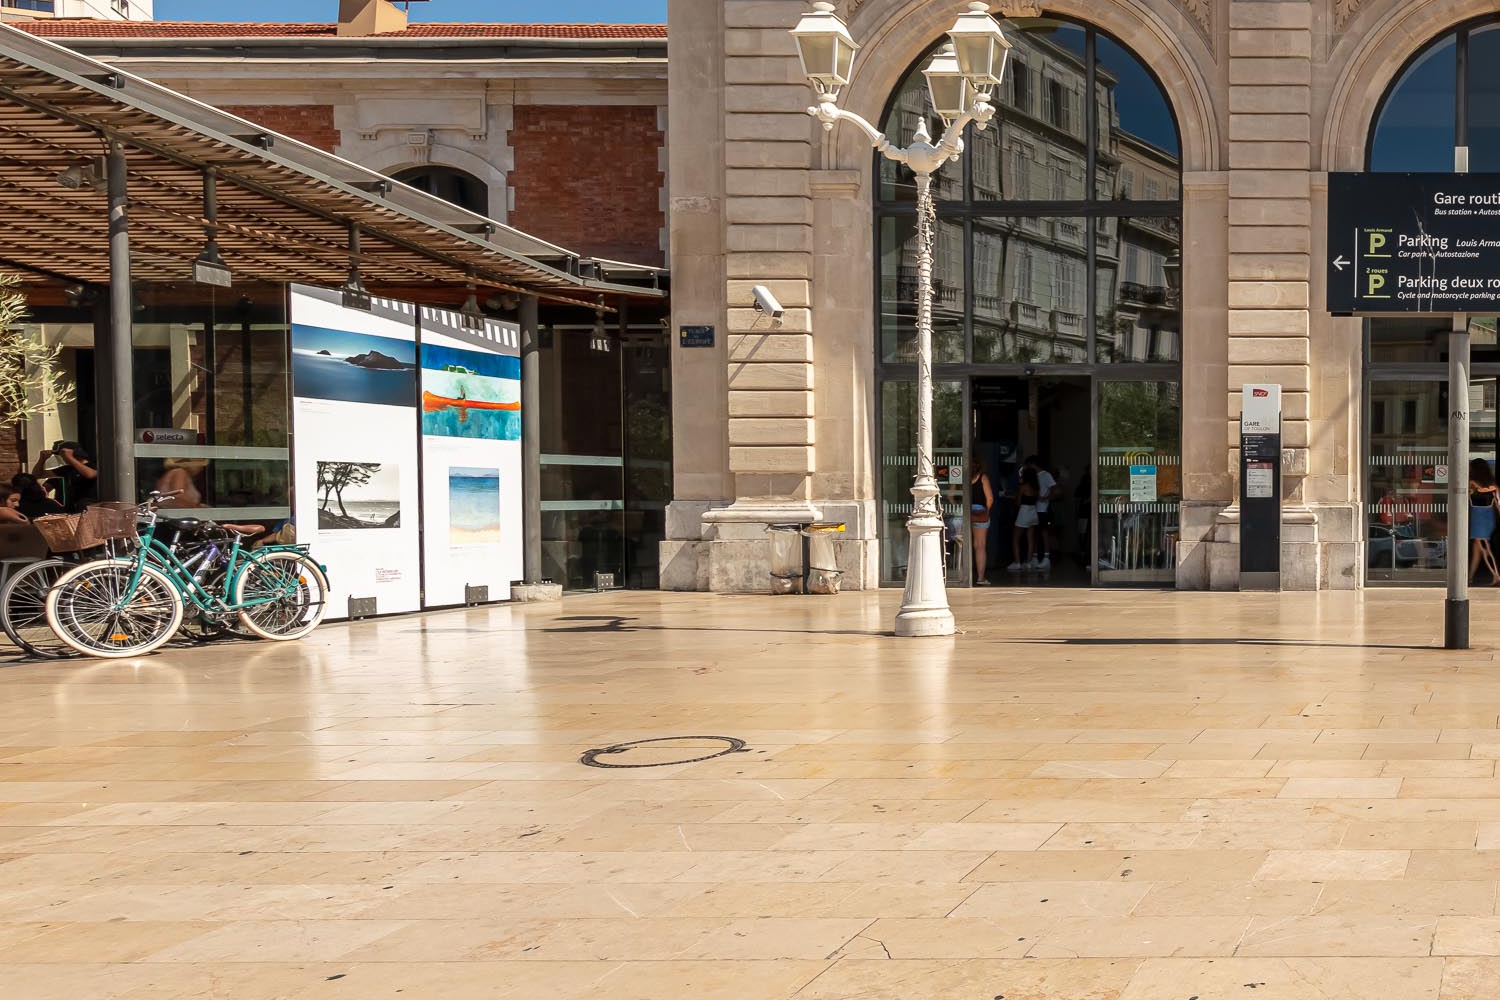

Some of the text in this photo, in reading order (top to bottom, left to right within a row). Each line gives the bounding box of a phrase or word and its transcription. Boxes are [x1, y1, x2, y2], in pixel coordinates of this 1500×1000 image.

[1434, 192, 1466, 205] Gare
[1434, 208, 1447, 216] Bus
[1448, 208, 1472, 216] station
[1398, 234, 1449, 250] Parking
[1456, 239, 1478, 248] Louis
[1398, 250, 1480, 259] Car park Autostazione
[1398, 275, 1448, 291] Parking
[1451, 275, 1484, 288] deux
[1397, 291, 1416, 300] Cycle
[1431, 292, 1469, 300] motorcycle
[1469, 292, 1496, 301] parking
